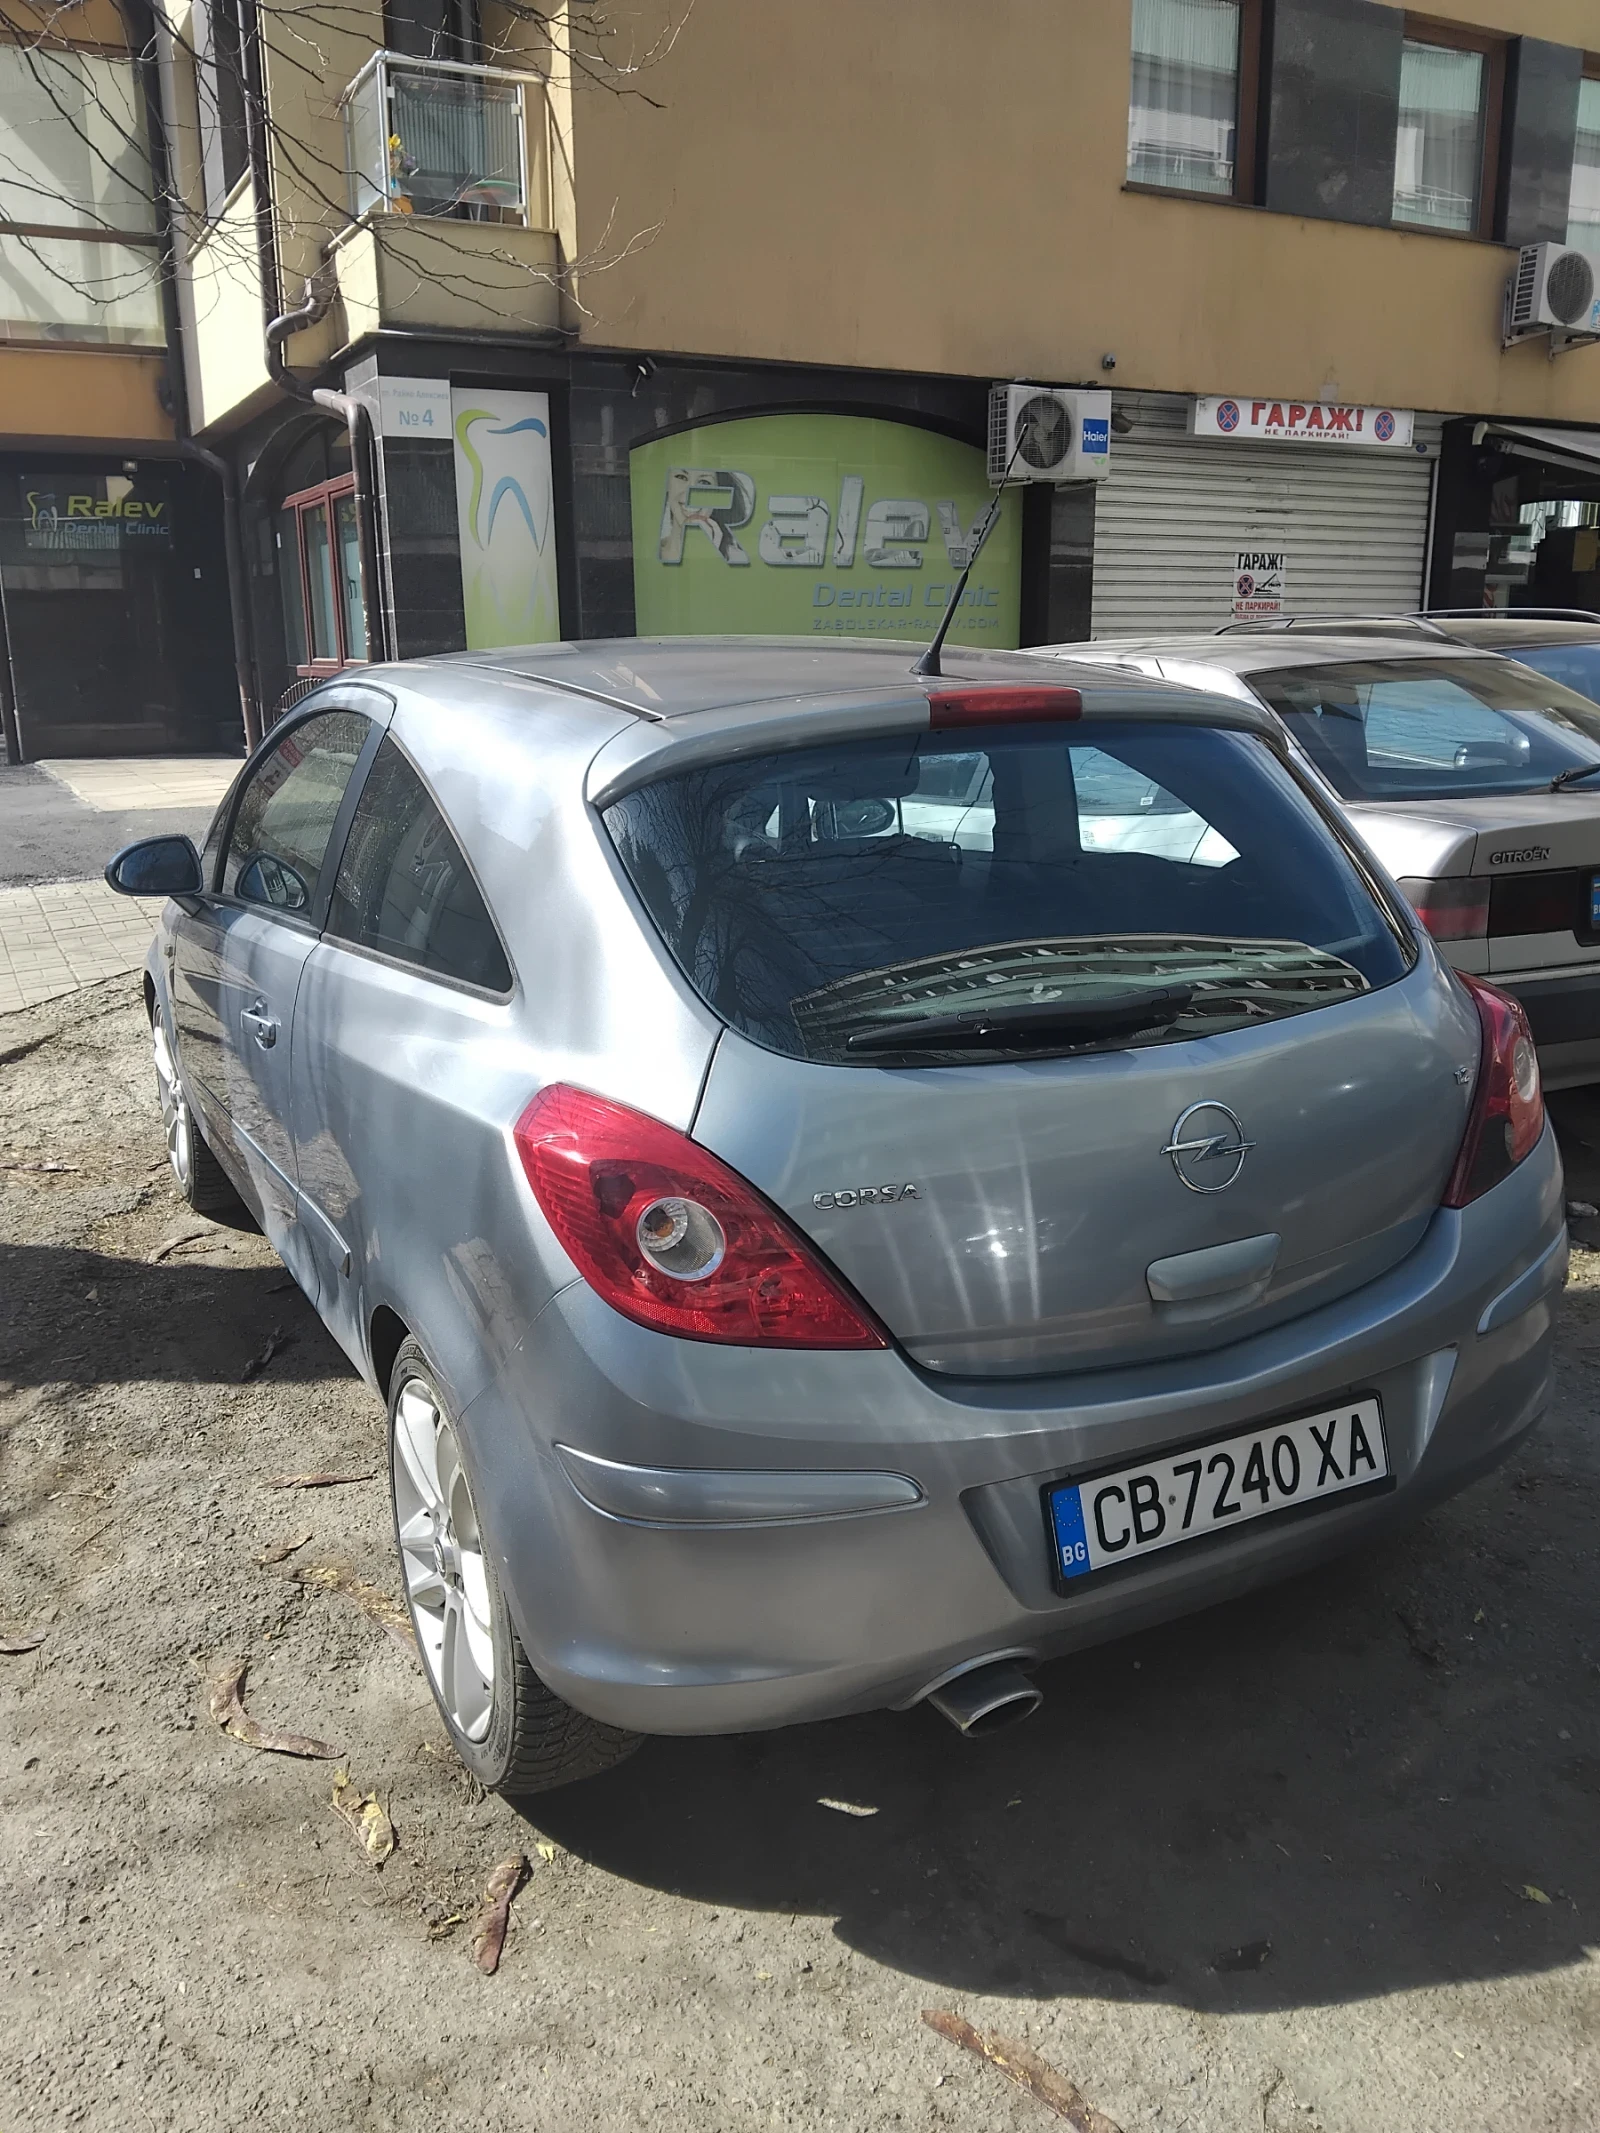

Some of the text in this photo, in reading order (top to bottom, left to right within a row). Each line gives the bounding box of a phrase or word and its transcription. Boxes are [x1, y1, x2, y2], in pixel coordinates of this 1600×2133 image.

[1251, 402, 1364, 432] ГАРАЖ!
[1083, 430, 1107, 442] Haier
[1264, 428, 1350, 440] НЕ ПАРКИРАЙ!
[67, 495, 165, 518] Ralev
[64, 521, 169, 535] Dental Clinic
[658, 467, 1001, 568] Ralev
[1237, 553, 1283, 571] ГАРАЖ!
[812, 582, 999, 608] Dental Clnic
[1235, 601, 1244, 611] НЕ
[812, 616, 999, 630] ZABOLEKAR-RALV.COM
[1490, 846, 1551, 865] CITROËN
[813, 1183, 922, 1210] CORSA
[1093, 1413, 1378, 1553] CB 7240 XA
[1062, 1541, 1087, 1567] BG
